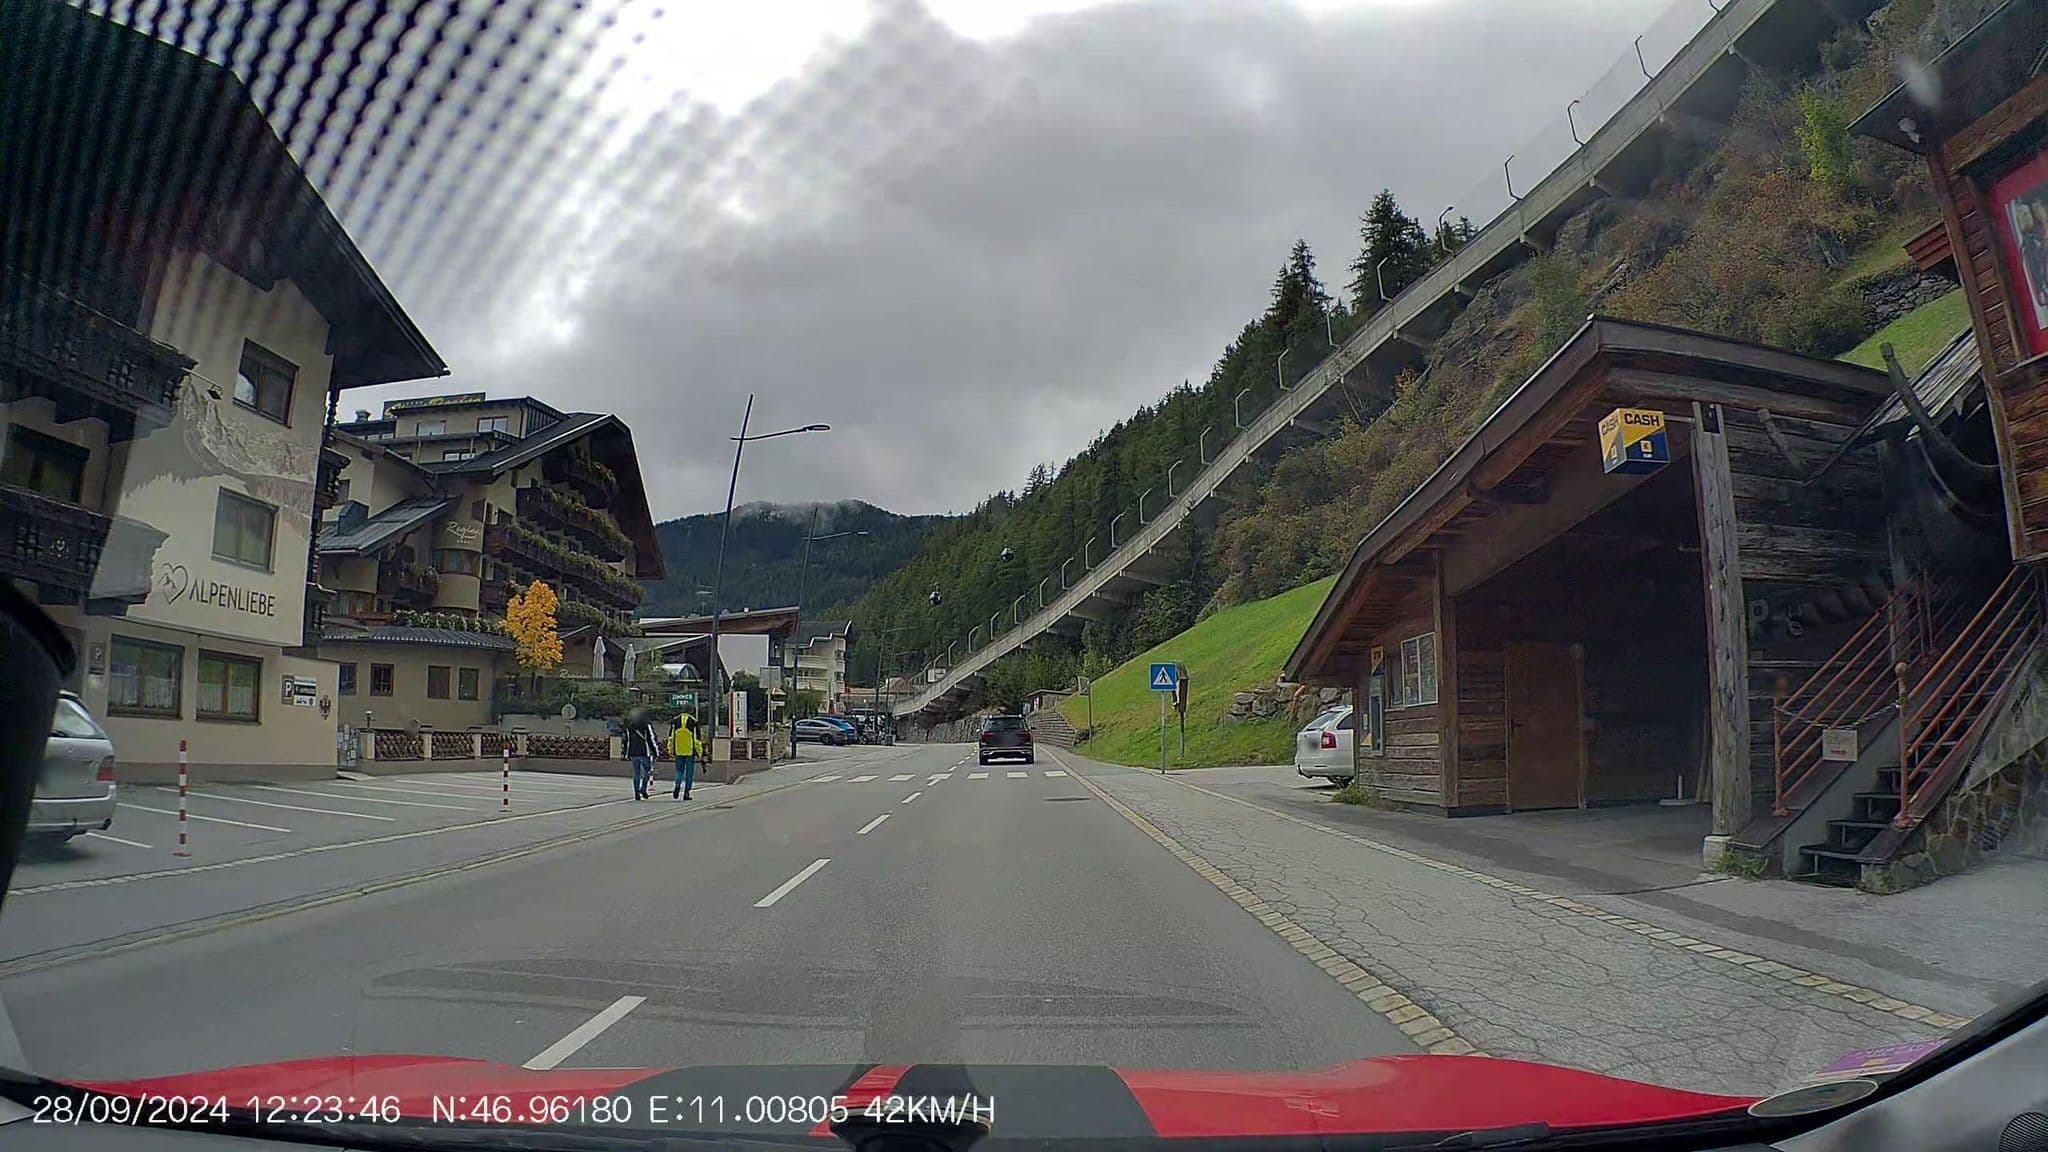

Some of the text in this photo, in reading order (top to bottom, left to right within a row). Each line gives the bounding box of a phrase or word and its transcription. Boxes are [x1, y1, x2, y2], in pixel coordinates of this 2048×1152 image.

[1624, 413, 1660, 427] CASH
[189, 578, 276, 617] ALPENLIEBE
[285, 681, 292, 697] P
